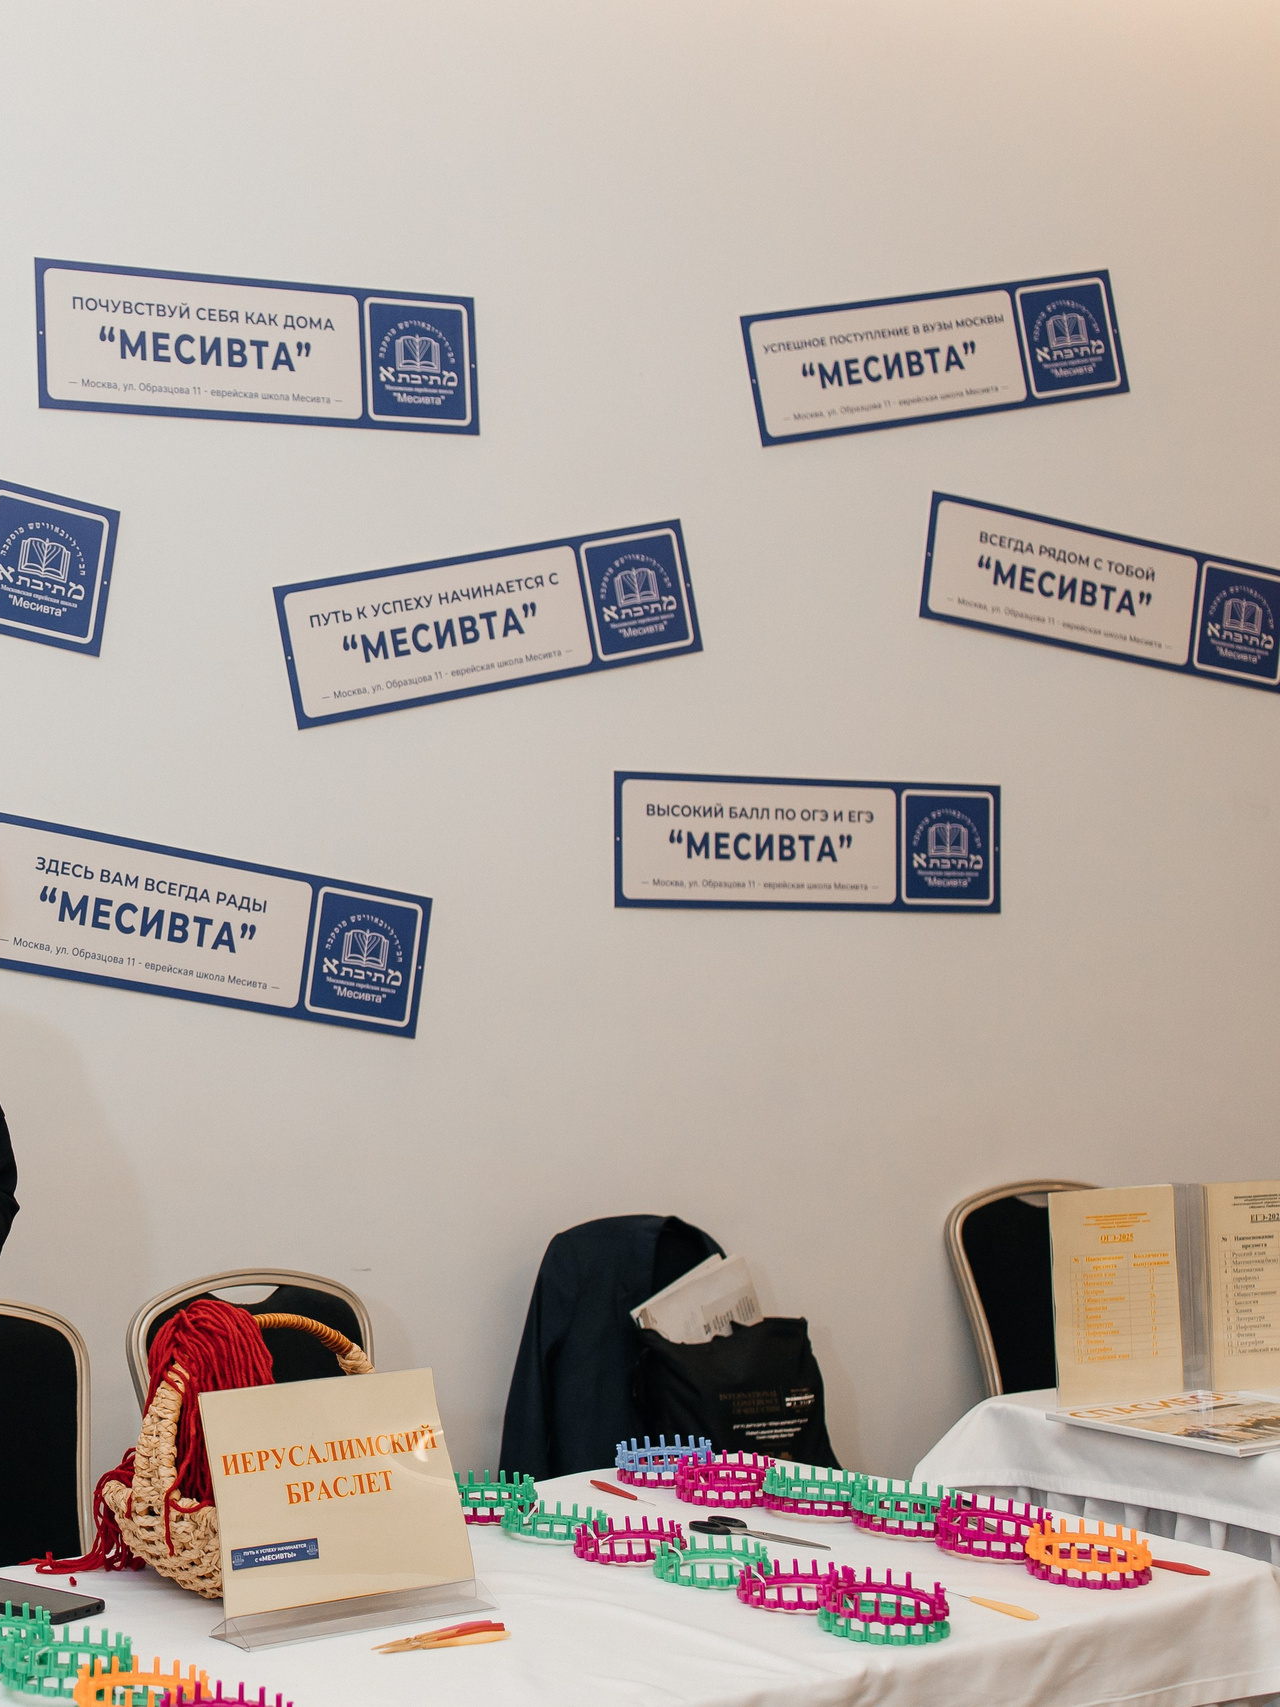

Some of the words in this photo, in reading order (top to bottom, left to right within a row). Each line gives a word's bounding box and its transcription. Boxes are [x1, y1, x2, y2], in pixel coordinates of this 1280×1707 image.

[72, 296, 190, 319] ПОЧУВСТВУЙ
[196, 307, 239, 323] СЕБЯ
[245, 311, 278, 326] КАК
[283, 314, 335, 331] ДОМА
[99, 325, 311, 372] “МЕСИВТА”
[763, 337, 825, 353] УСПЕШНОЕ
[829, 326, 908, 345] ПОСТУПЛЕНИЕ
[912, 325, 920, 334] В
[922, 321, 953, 333] ВУЗЫ
[955, 314, 1004, 328] МОСКВЫ
[380, 366, 457, 387] מתיבתא
[801, 340, 975, 389] “МЕСИВТА”
[81, 378, 120, 391] Москва,
[123, 383, 136, 392] ул.
[138, 382, 190, 395] Образцова
[192, 386, 200, 395] 11
[210, 389, 259, 399] еврейская
[261, 392, 289, 401] школа
[291, 393, 330, 404] Месивта
[979, 531, 1034, 554] ВСЕГДА
[1038, 545, 1090, 567] РЯДОМ
[1093, 558, 1102, 570] С
[1107, 560, 1155, 582] ТОБОЙ
[309, 609, 352, 628] ПУТЬ
[356, 606, 367, 620] К
[370, 594, 432, 617] УСПЕХУ
[438, 575, 544, 605] НАЧИНАЕТСЯ
[548, 572, 559, 585] С
[977, 555, 1152, 616] “МЕСИВТА”
[8, 594, 67, 617] "Месивта"
[602, 595, 676, 622] מתיבתא
[342, 601, 536, 663] “МЕСИВТА”
[385, 674, 432, 689] Образцова
[434, 670, 442, 680] 11
[450, 662, 496, 677] еврейская
[497, 657, 524, 668] школа
[525, 650, 562, 662] Месивта
[646, 803, 723, 818] ВЫСОКИЙ
[729, 806, 770, 820] БАЛЛ
[774, 808, 796, 821] ПО
[800, 809, 829, 821] ОГЭ
[833, 810, 843, 822] И
[848, 810, 874, 823] ЕГЭ
[669, 829, 852, 862] “МЕСИВТА”
[35, 856, 94, 880] ЗДЕСЬ
[99, 868, 139, 889] ВАМ
[144, 877, 210, 903] ВСЕГДА
[216, 891, 267, 913] РАДЫ
[39, 885, 256, 953] “МЕСИВТА”
[13, 936, 52, 953] Москва,
[55, 946, 68, 955] ул.
[71, 947, 124, 964] Образцова
[127, 956, 135, 966] 11
[144, 961, 194, 977] еврейская
[196, 971, 225, 982] школа
[227, 974, 267, 989] Месивта
[322, 957, 402, 986] מתיבתא
[333, 985, 386, 1003] "Месивта"
[221, 1424, 438, 1476] ИЕРУСАЛИМСКИЙ
[286, 1470, 393, 1505] БРАСЛЕТ
